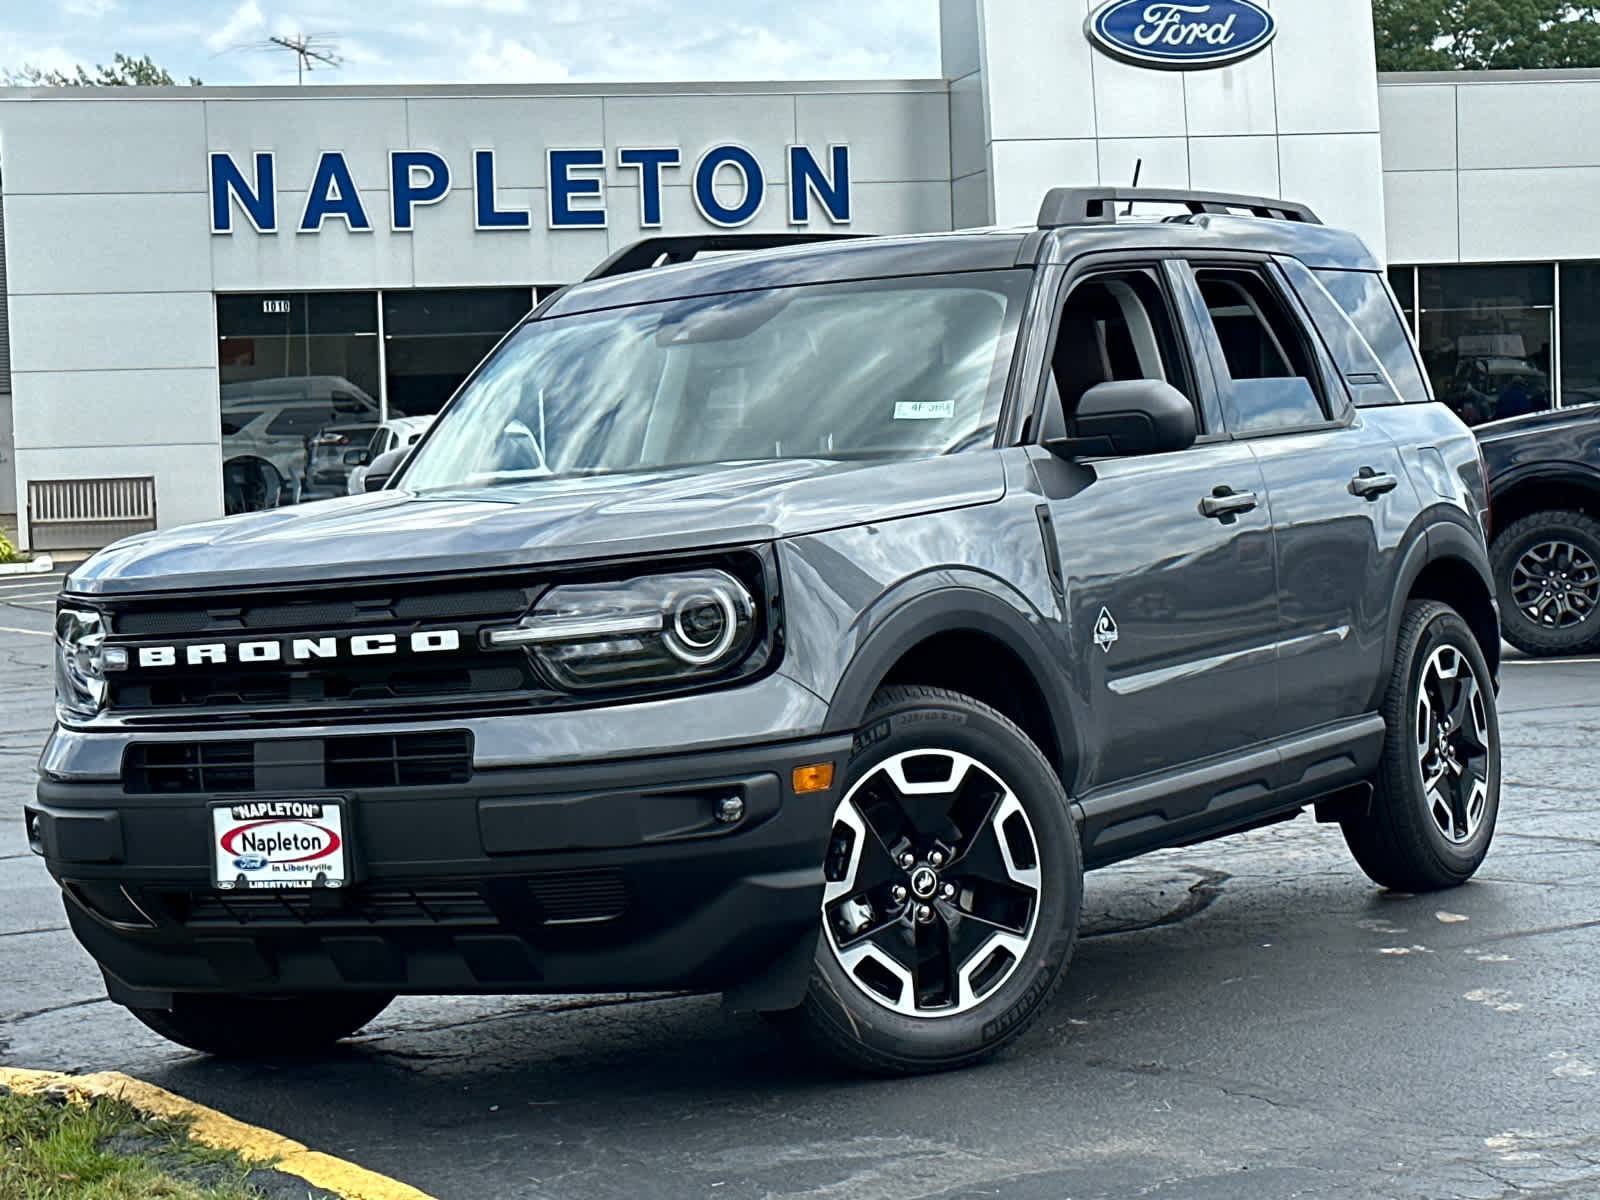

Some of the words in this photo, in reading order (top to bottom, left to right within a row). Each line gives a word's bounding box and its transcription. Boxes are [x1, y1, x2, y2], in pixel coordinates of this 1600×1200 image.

[1134, 3, 1237, 45] Ford
[207, 144, 851, 234] NAPLETON
[138, 629, 459, 668] BRONCO
[239, 802, 313, 819] NAPLETON
[241, 832, 322, 856] Napleton
[283, 862, 332, 873] Libertyville
